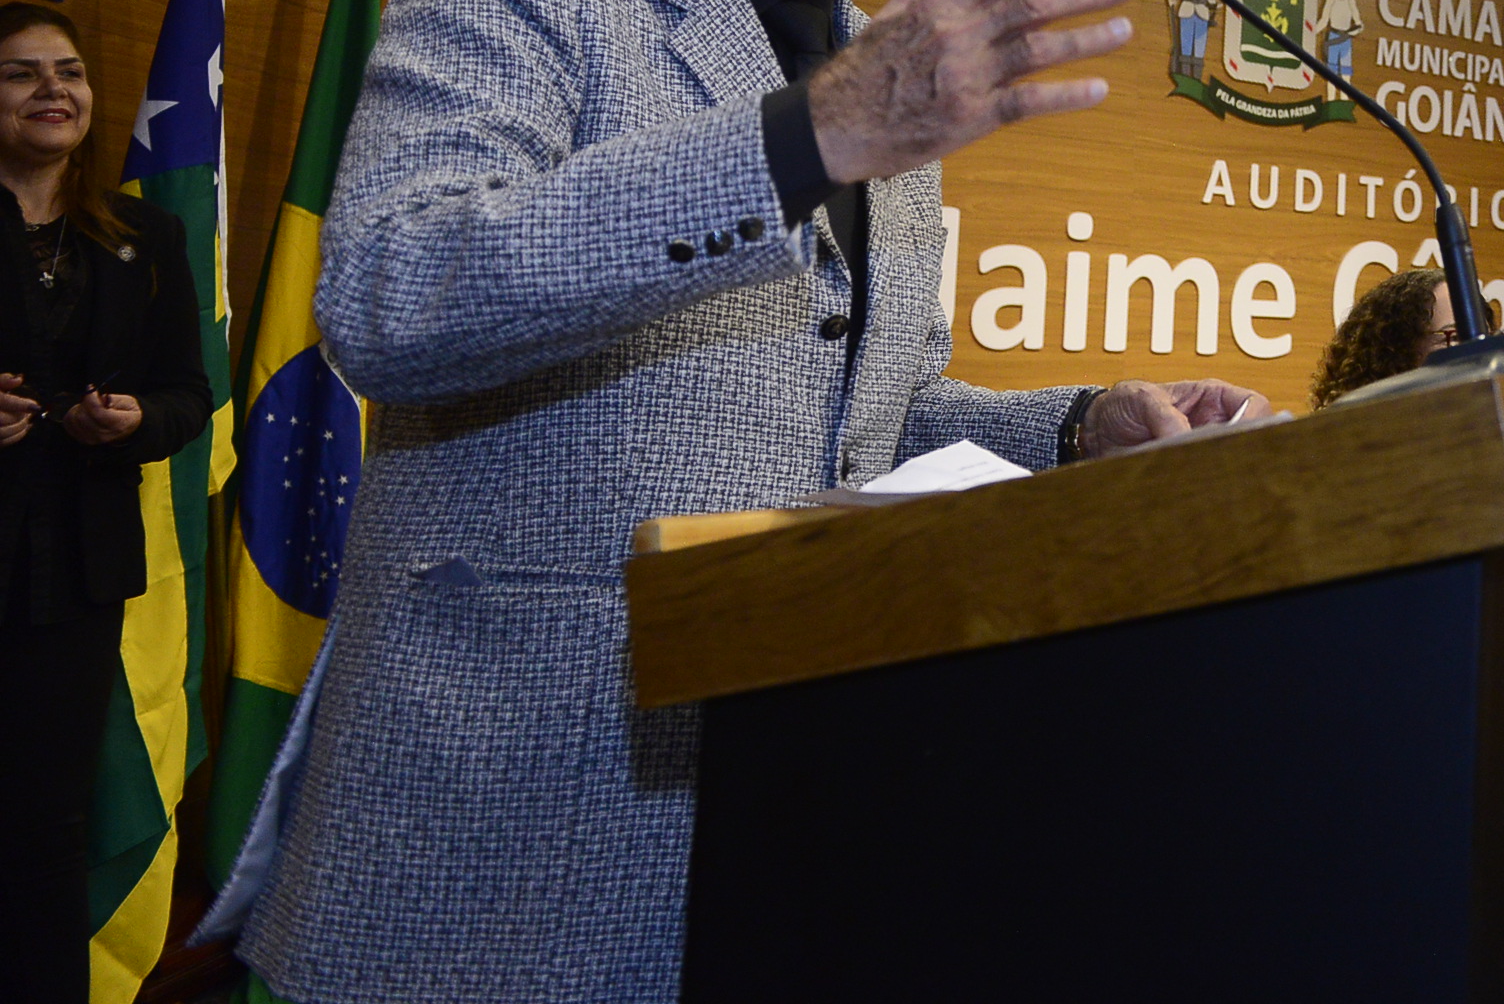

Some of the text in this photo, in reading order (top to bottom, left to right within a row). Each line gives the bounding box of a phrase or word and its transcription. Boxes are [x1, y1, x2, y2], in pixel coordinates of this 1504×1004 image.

[1216, 88, 1235, 106] PELA
[1236, 99, 1277, 118] GRANDEZA
[1277, 108, 1290, 119] DA
